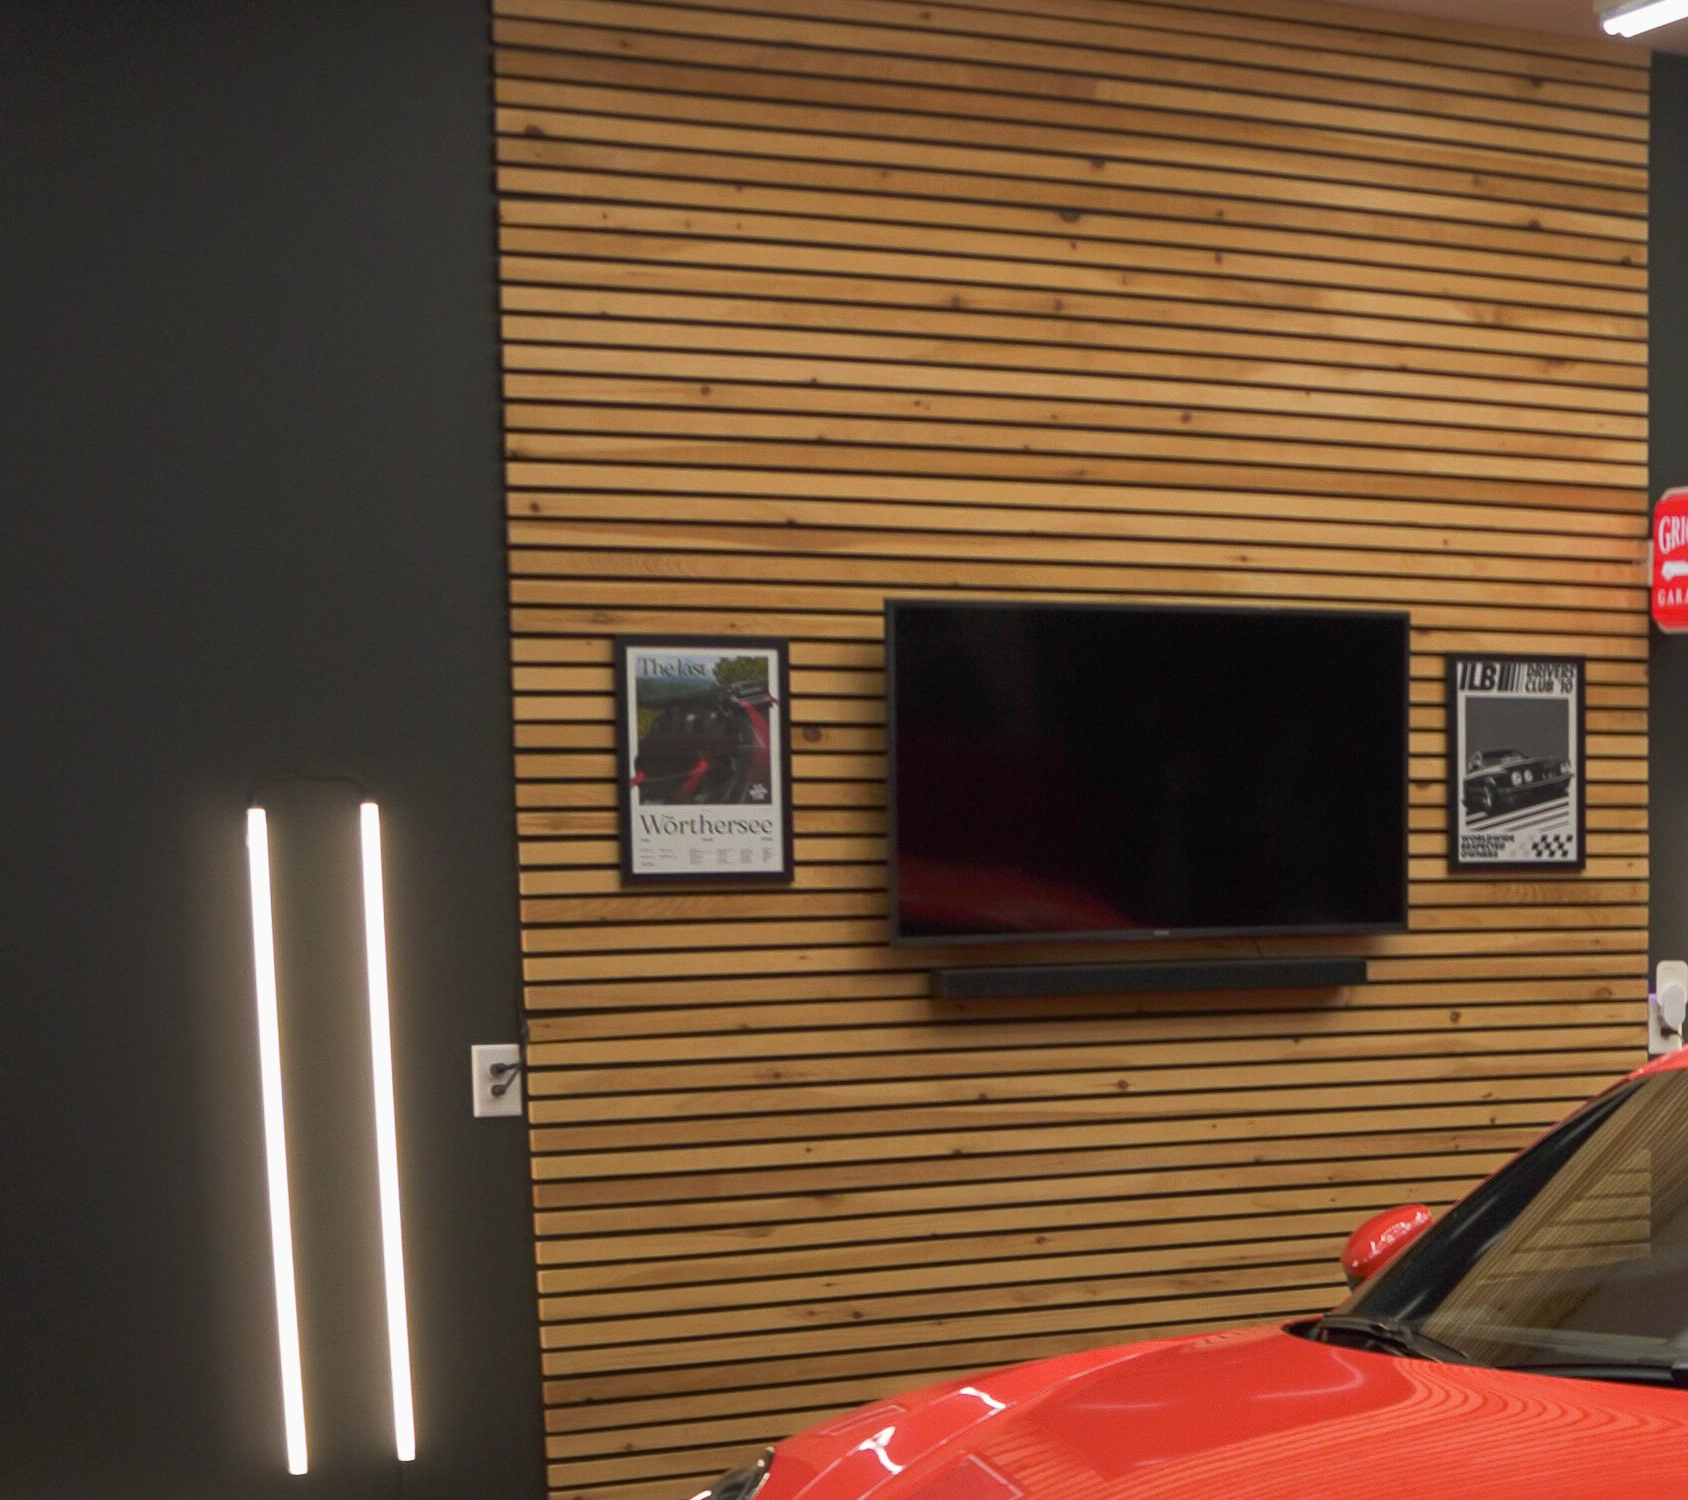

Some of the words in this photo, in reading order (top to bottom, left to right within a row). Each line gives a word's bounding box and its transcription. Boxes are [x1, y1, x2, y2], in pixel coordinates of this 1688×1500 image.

[638, 657, 673, 677] The
[679, 657, 706, 677] last
[1526, 663, 1575, 678] DRIVERS
[1525, 679, 1554, 692] CLUB
